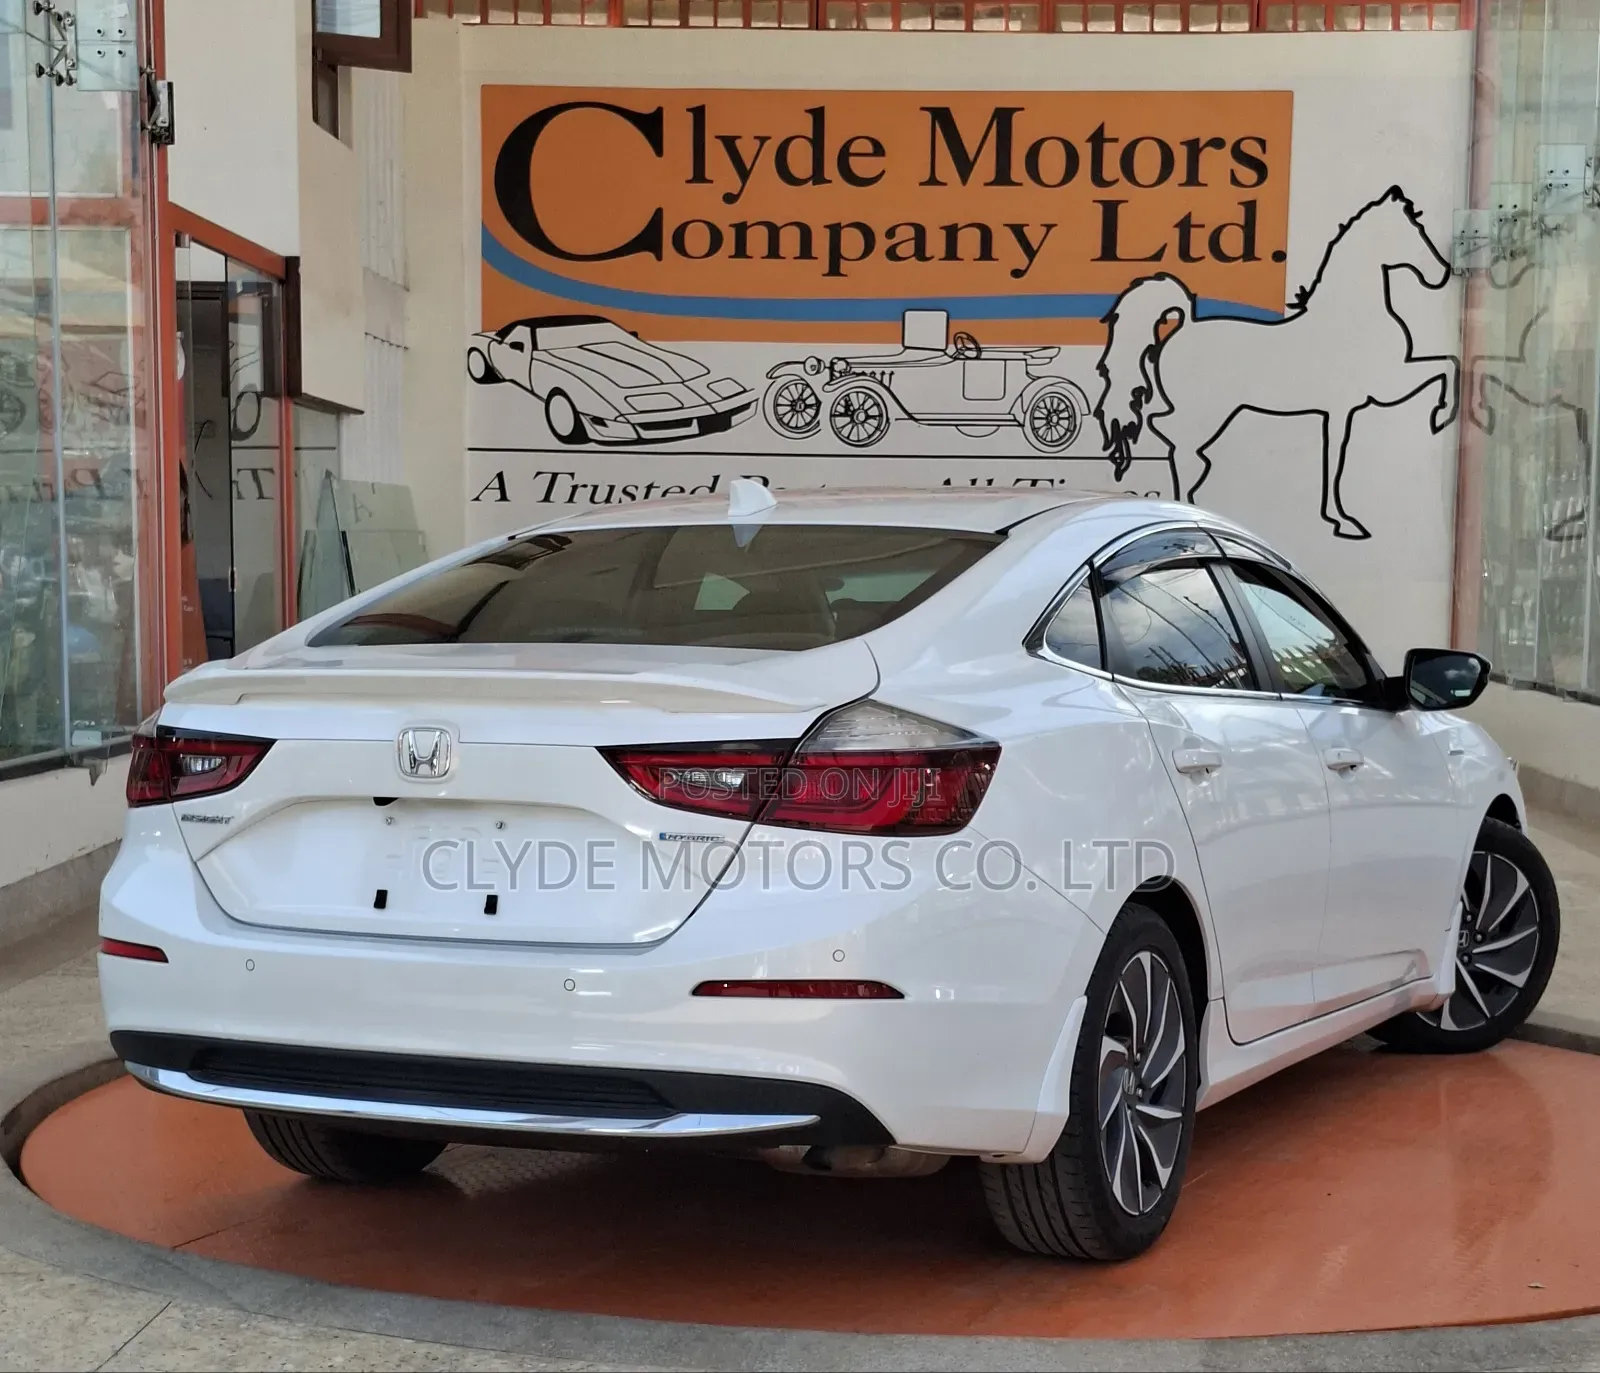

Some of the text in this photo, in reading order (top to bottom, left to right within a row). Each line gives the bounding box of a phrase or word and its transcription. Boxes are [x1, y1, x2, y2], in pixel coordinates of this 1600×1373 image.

[919, 106, 1269, 189] Motors
[1091, 199, 1287, 263] Ltd.
[471, 470, 511, 503] A
[532, 470, 721, 505] Trusted
